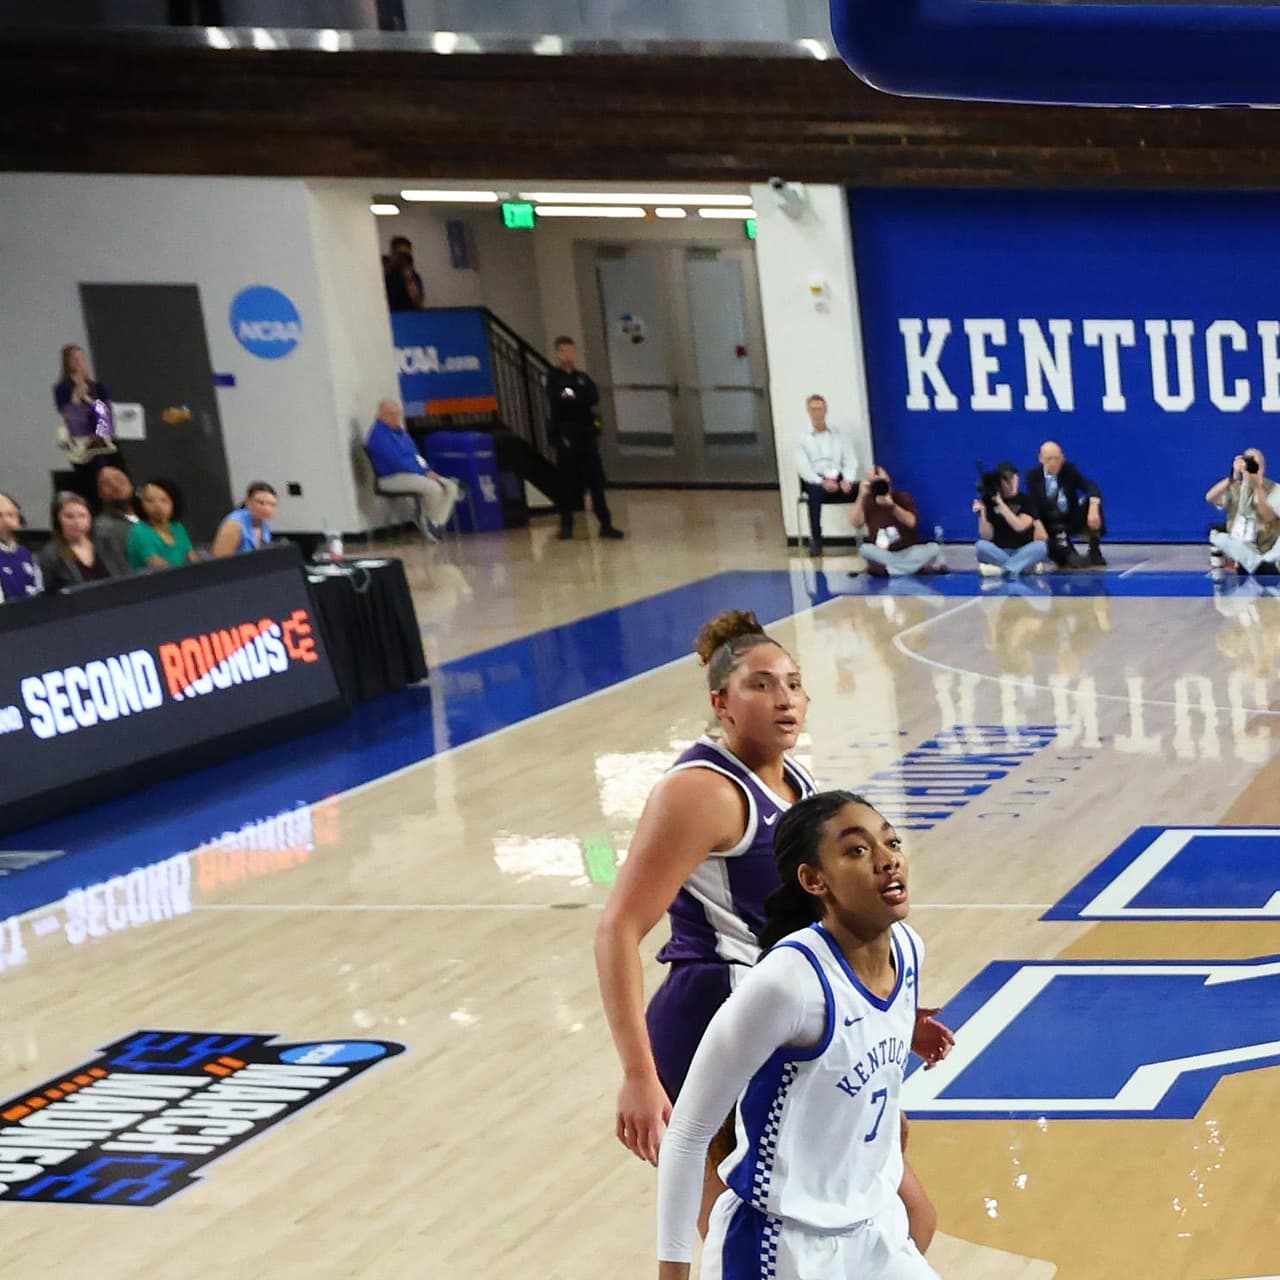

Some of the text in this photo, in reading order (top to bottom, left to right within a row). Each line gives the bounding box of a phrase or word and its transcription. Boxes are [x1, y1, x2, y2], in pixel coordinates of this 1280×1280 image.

[238, 320, 299, 342] NCAA
[21, 649, 163, 739] SECOND
[159, 617, 289, 702] ROUNDS
[836, 1037, 908, 1098] KENTUC
[0, 1072, 214, 1196] MADNE
[100, 1062, 351, 1155] MARCH
[864, 1087, 888, 1143] 7
